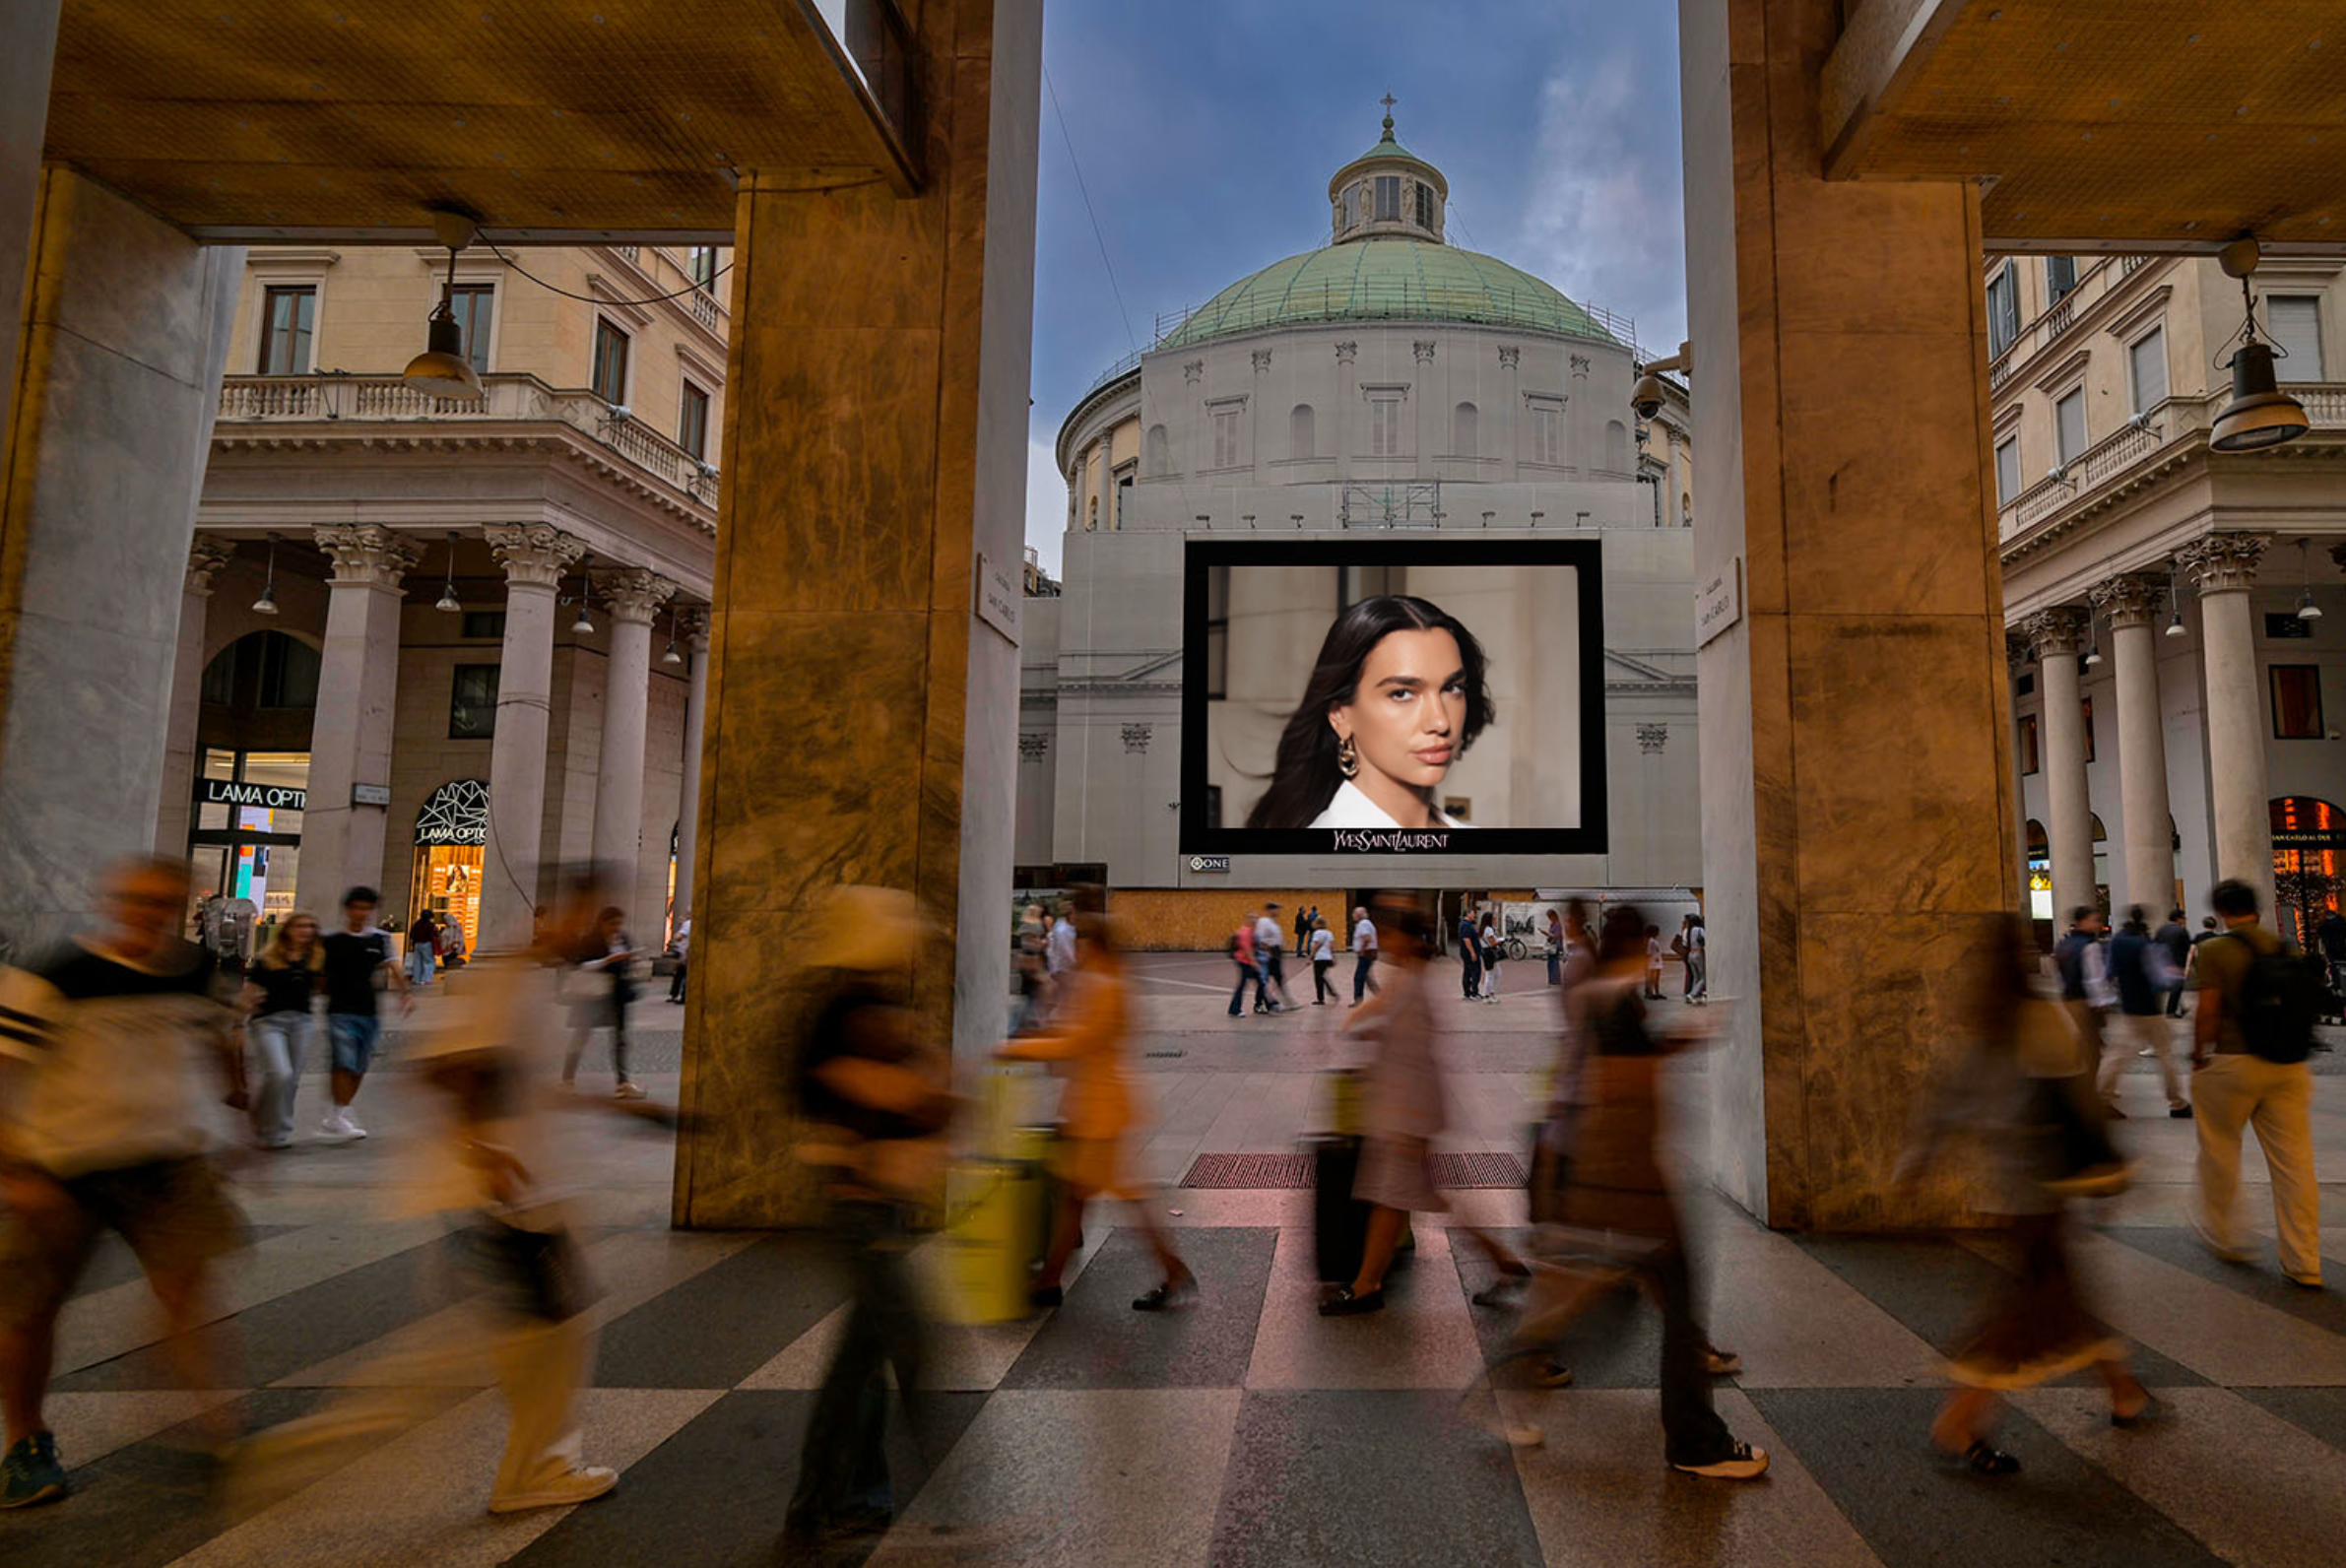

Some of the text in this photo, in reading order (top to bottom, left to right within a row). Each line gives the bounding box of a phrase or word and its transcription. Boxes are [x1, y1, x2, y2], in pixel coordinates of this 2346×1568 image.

[209, 782, 263, 805] LAMA
[421, 827, 455, 840] LAMA
[1203, 858, 1229, 868] ONE
